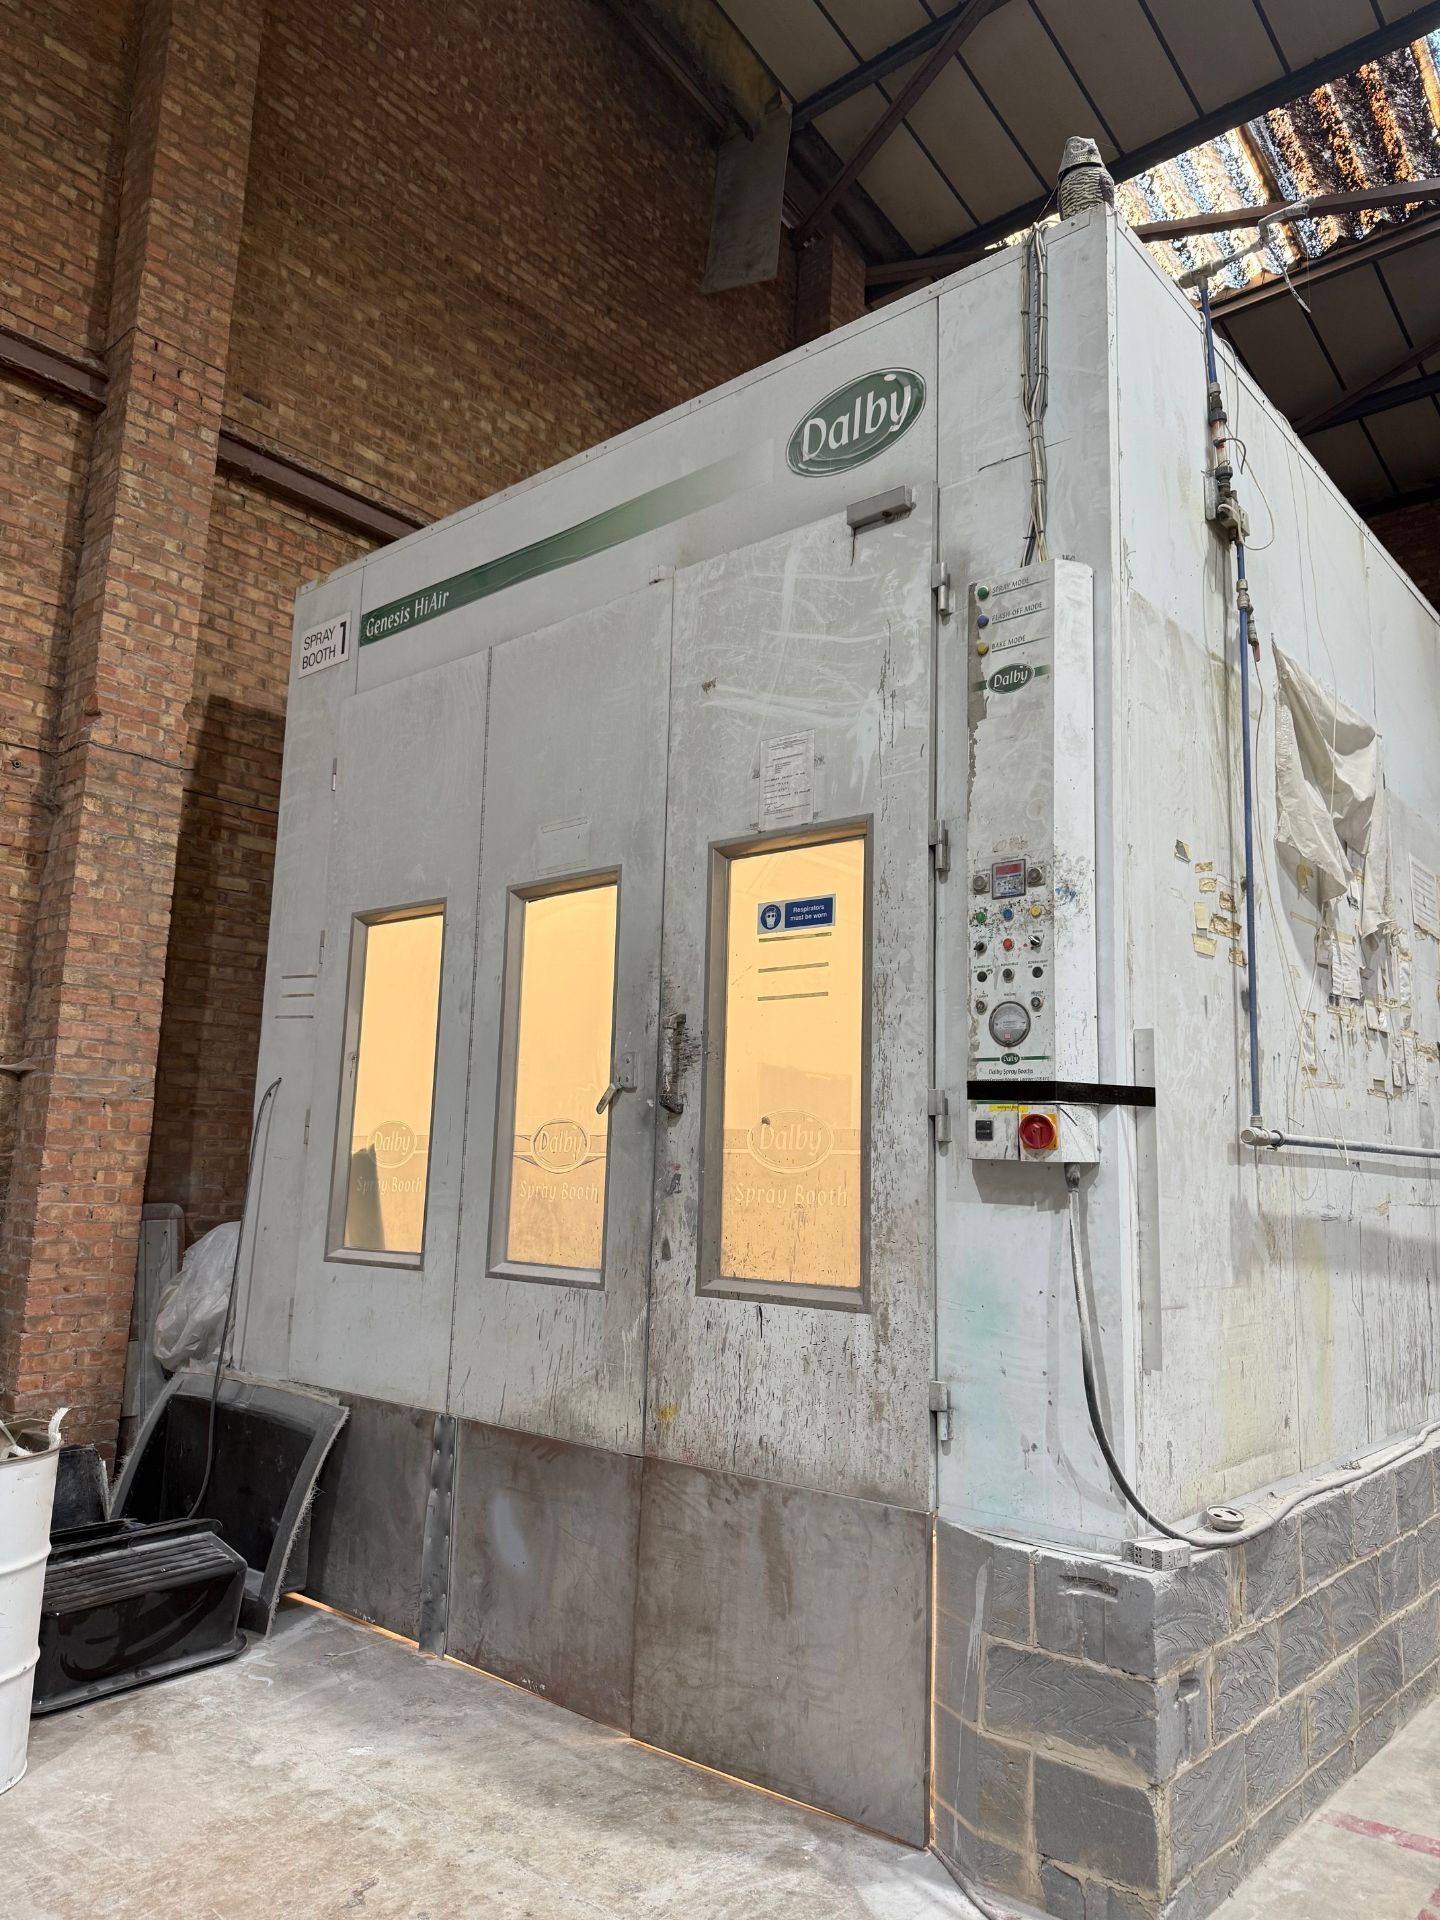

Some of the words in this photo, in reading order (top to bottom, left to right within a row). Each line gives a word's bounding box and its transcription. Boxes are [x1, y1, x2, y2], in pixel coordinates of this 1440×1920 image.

[802, 374, 912, 462] Dalby
[992, 582, 1011, 593] SPRAY
[1011, 577, 1029, 587] MODE
[366, 606, 410, 637] Genesis
[414, 591, 450, 618] HiAir
[1024, 602, 1043, 612] MODE
[304, 626, 336, 651] SPRAY
[340, 621, 347, 655] 1
[992, 640, 1006, 650] BAKE
[1008, 635, 1026, 645] MODE
[302, 644, 336, 670] BOOTH
[993, 665, 1028, 688] Dalby
[793, 904, 825, 914] Respirators
[374, 1128, 411, 1156] Dalby
[539, 1127, 583, 1159] Dalby
[759, 1121, 822, 1156] Dalby
[391, 1176, 423, 1193] Booth
[519, 1180, 557, 1202] Spray
[561, 1181, 599, 1202] Booth
[735, 1183, 787, 1208] Spray
[795, 1184, 848, 1208] Booth
